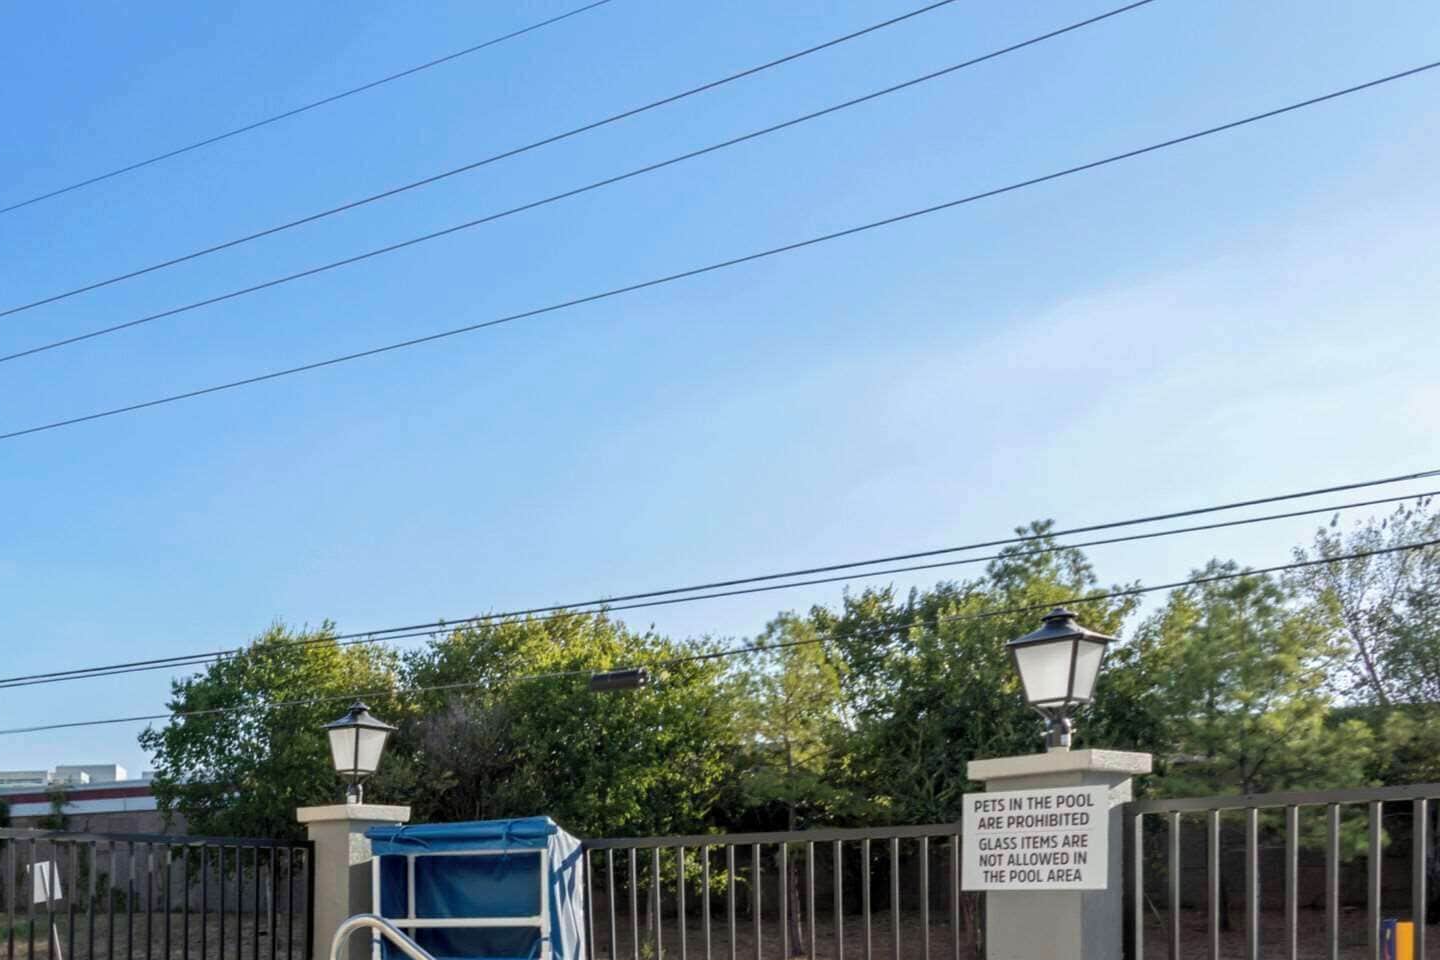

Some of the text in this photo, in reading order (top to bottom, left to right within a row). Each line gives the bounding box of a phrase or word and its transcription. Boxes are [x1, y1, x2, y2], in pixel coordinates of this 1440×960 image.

[974, 793, 1095, 813] PETS IN THE POOL
[977, 812, 1090, 830] ARE PROHIBITED
[978, 833, 1089, 851] GLASS ITEMS ARE
[979, 851, 1088, 868] NOT ALLOWED IN
[983, 869, 1083, 883] THE POOL AREA
